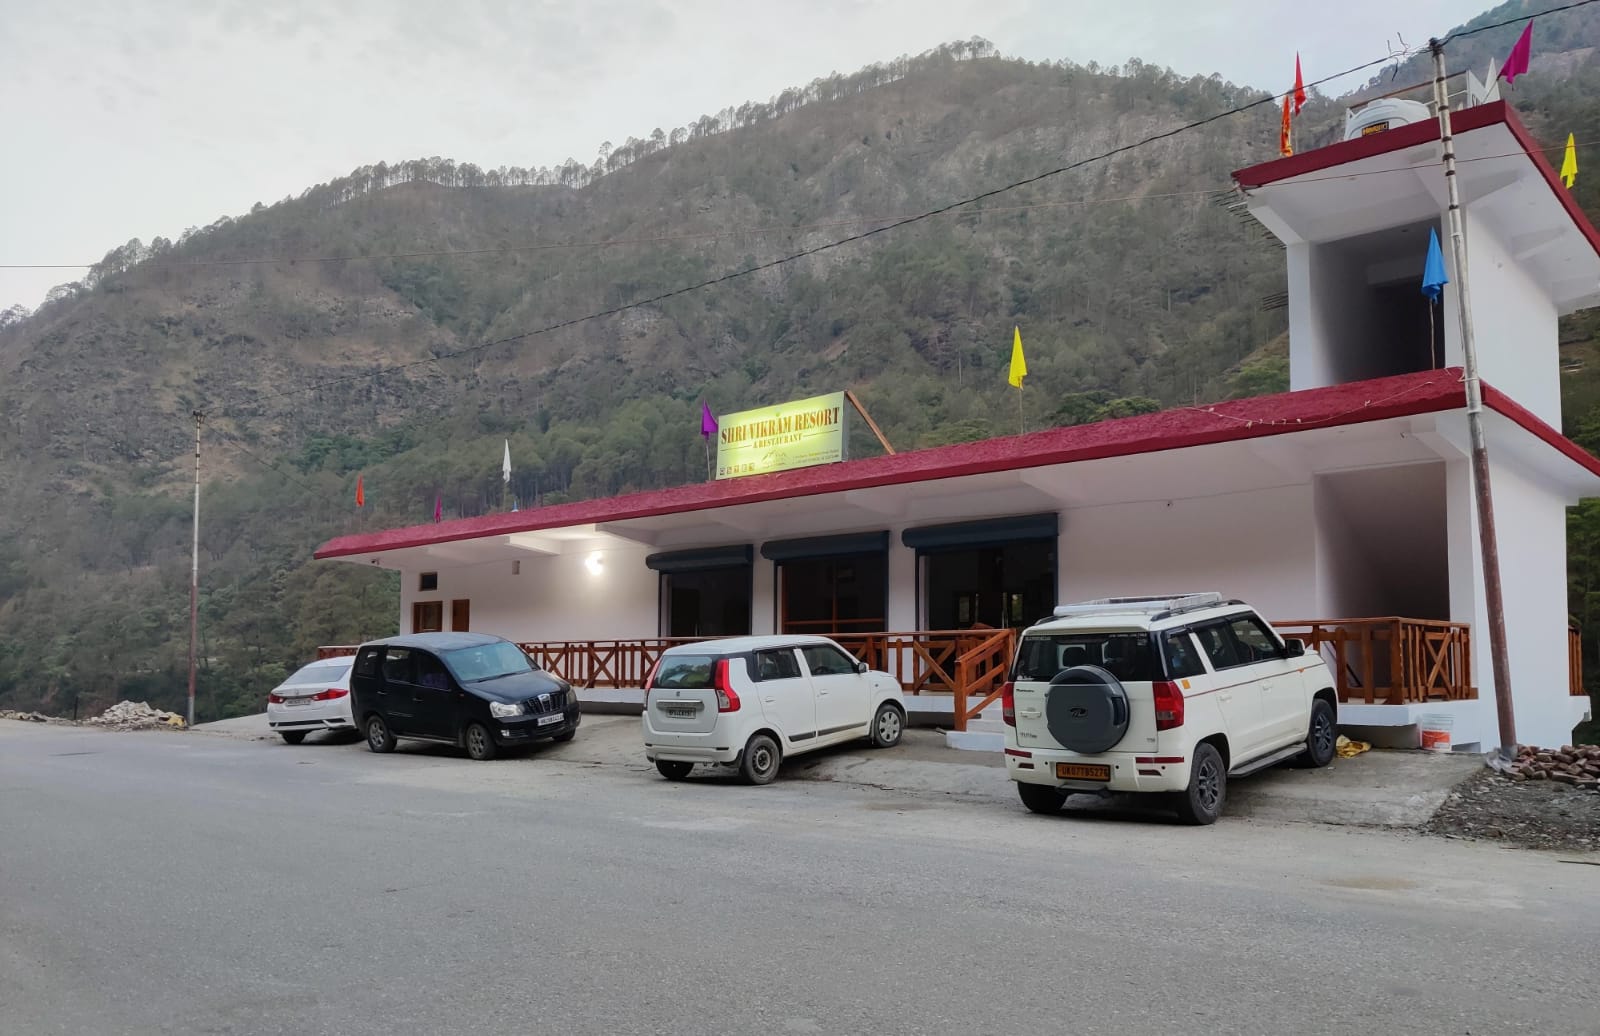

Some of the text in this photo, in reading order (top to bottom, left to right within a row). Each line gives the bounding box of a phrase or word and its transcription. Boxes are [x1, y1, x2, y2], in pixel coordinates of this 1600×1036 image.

[721, 407, 840, 445] SHRI VIKRAM RESORT
[758, 434, 802, 448] RESTAURANT
